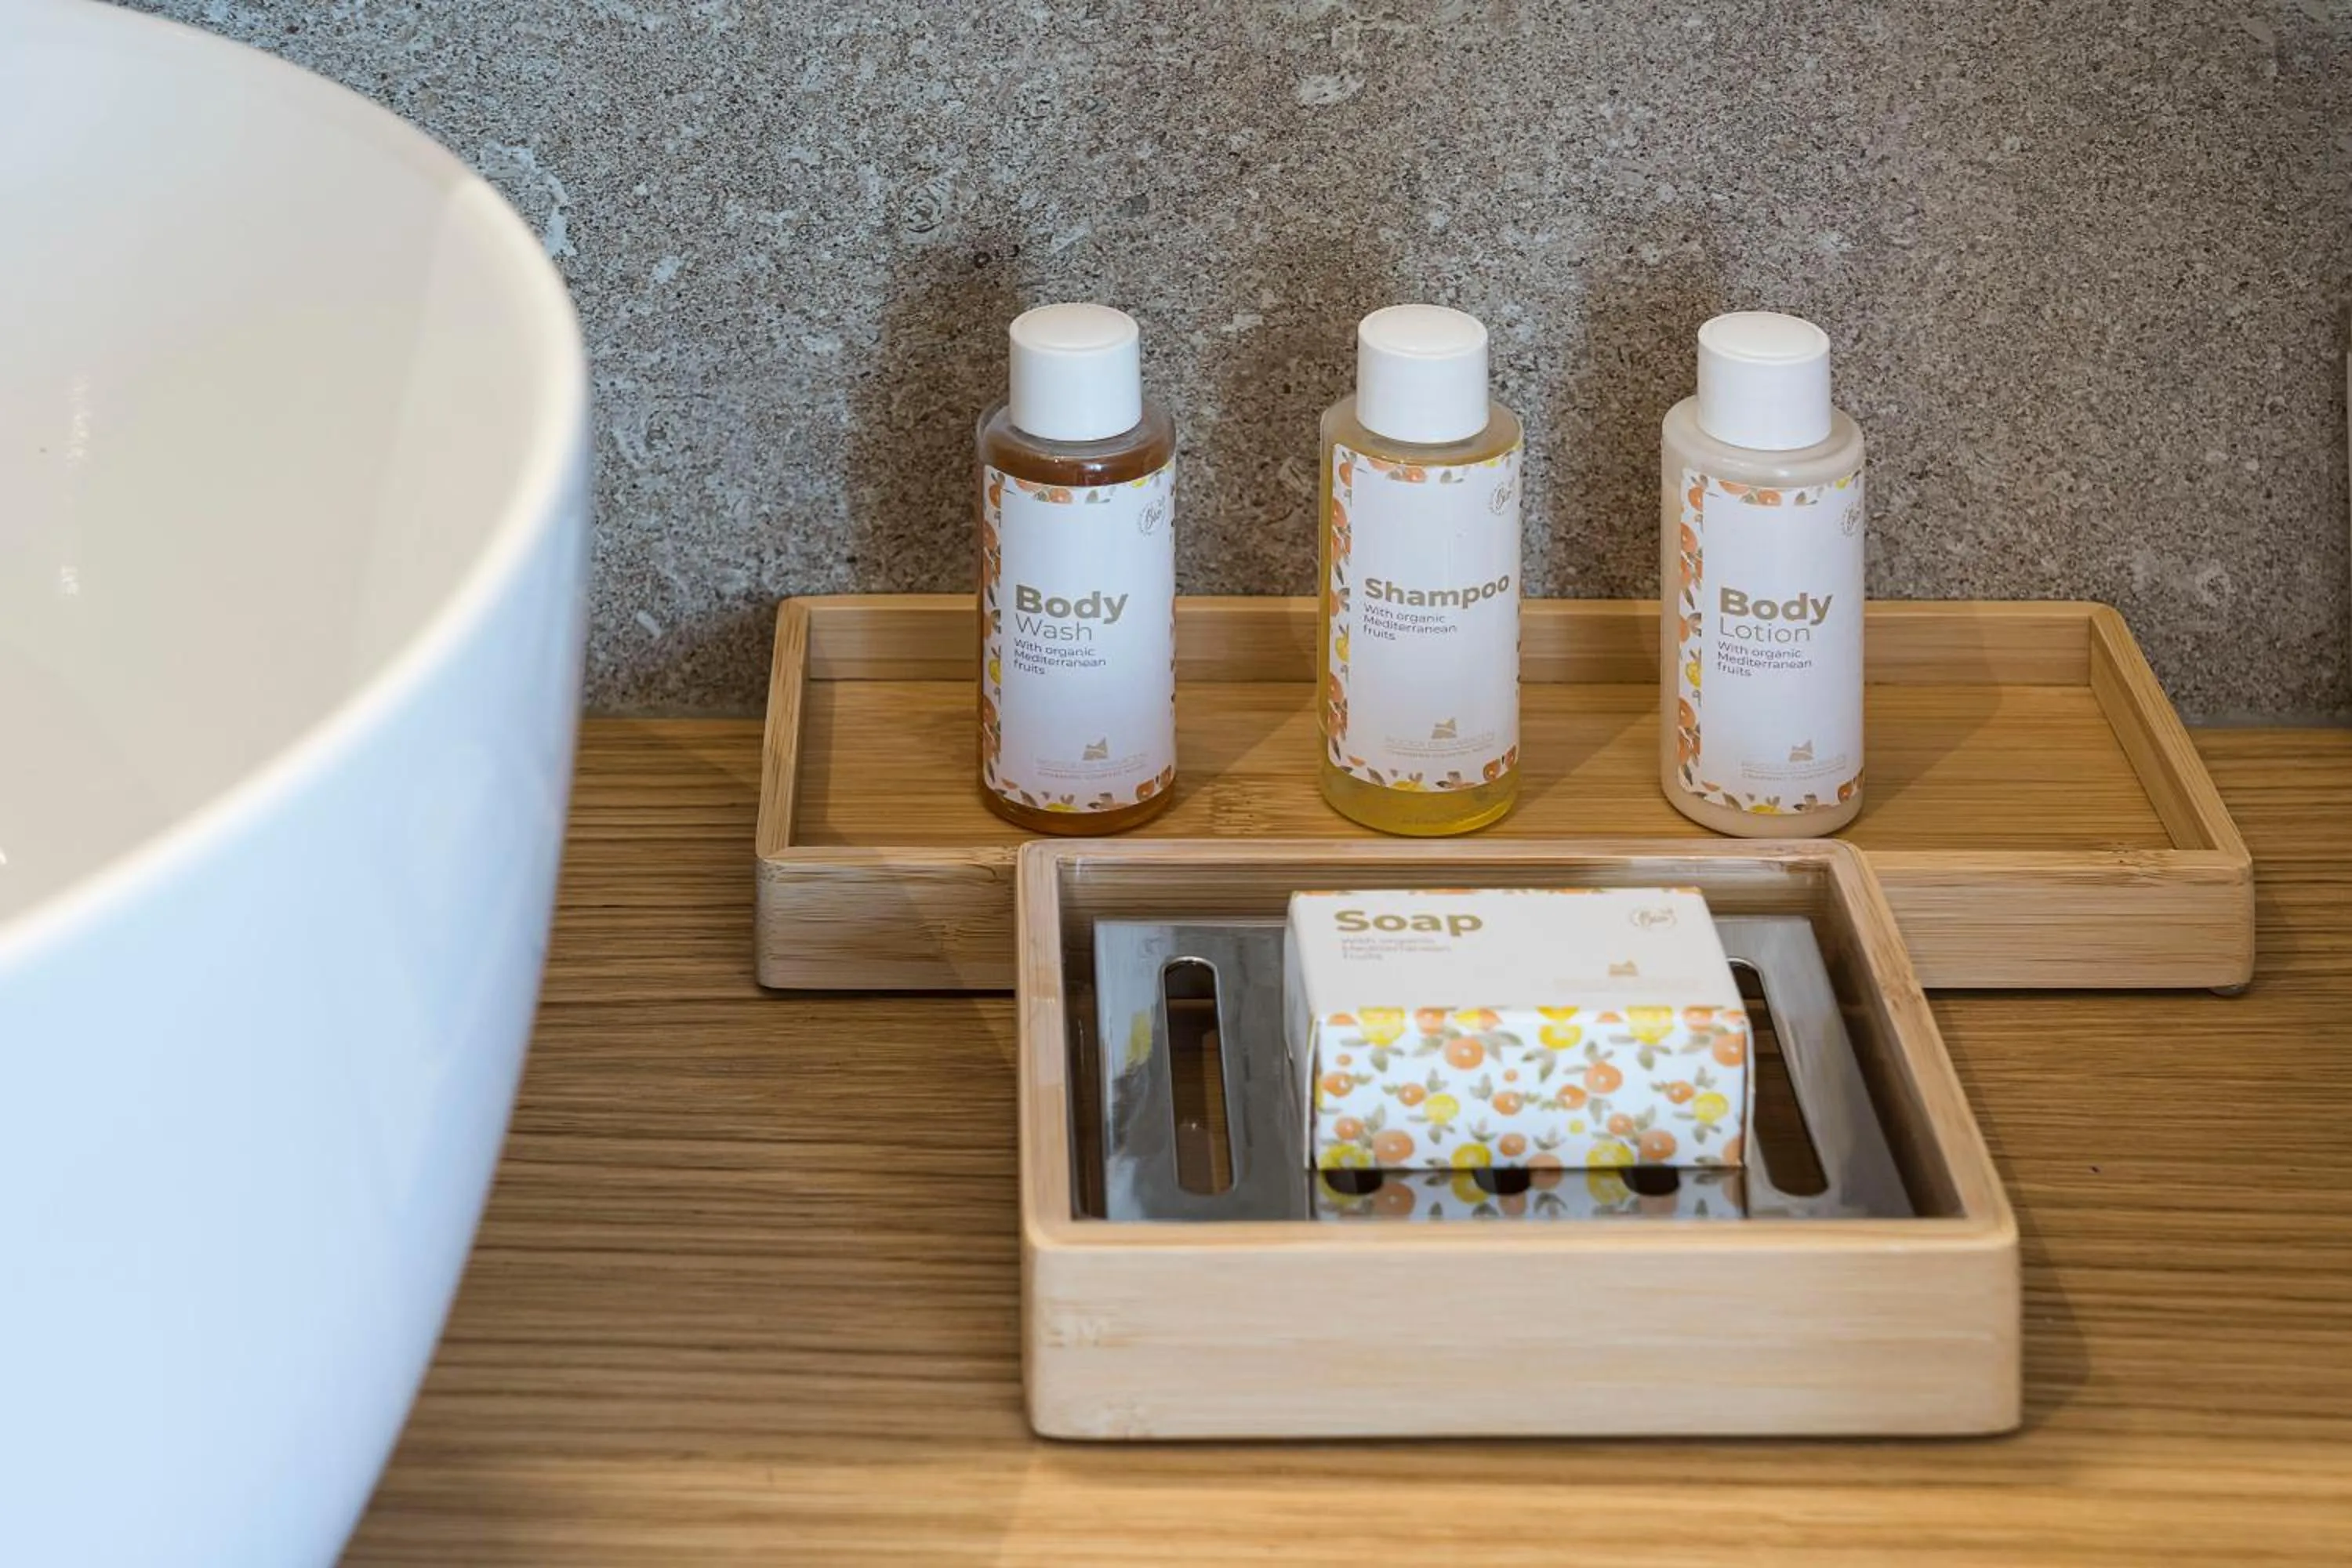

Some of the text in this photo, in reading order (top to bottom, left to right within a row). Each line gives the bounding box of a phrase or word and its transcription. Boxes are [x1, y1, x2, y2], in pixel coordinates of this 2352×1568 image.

[1364, 575, 1510, 609] Shampoo
[1015, 584, 1129, 625] Body
[1363, 603, 1446, 625] With organic
[1720, 586, 1834, 626] Body
[1015, 612, 1093, 641] Wash
[1363, 614, 1457, 635] Mediterranean
[1363, 624, 1396, 641] fruits
[1720, 615, 1811, 643] Lotion
[1014, 637, 1097, 658] With organic
[1014, 648, 1107, 667] Mediterranean
[1718, 641, 1802, 660] With organic
[1013, 659, 1046, 675] fruits
[1717, 661, 1753, 677] fruits
[1718, 651, 1813, 670] Mediterranean
[1334, 910, 1483, 938] Soap
